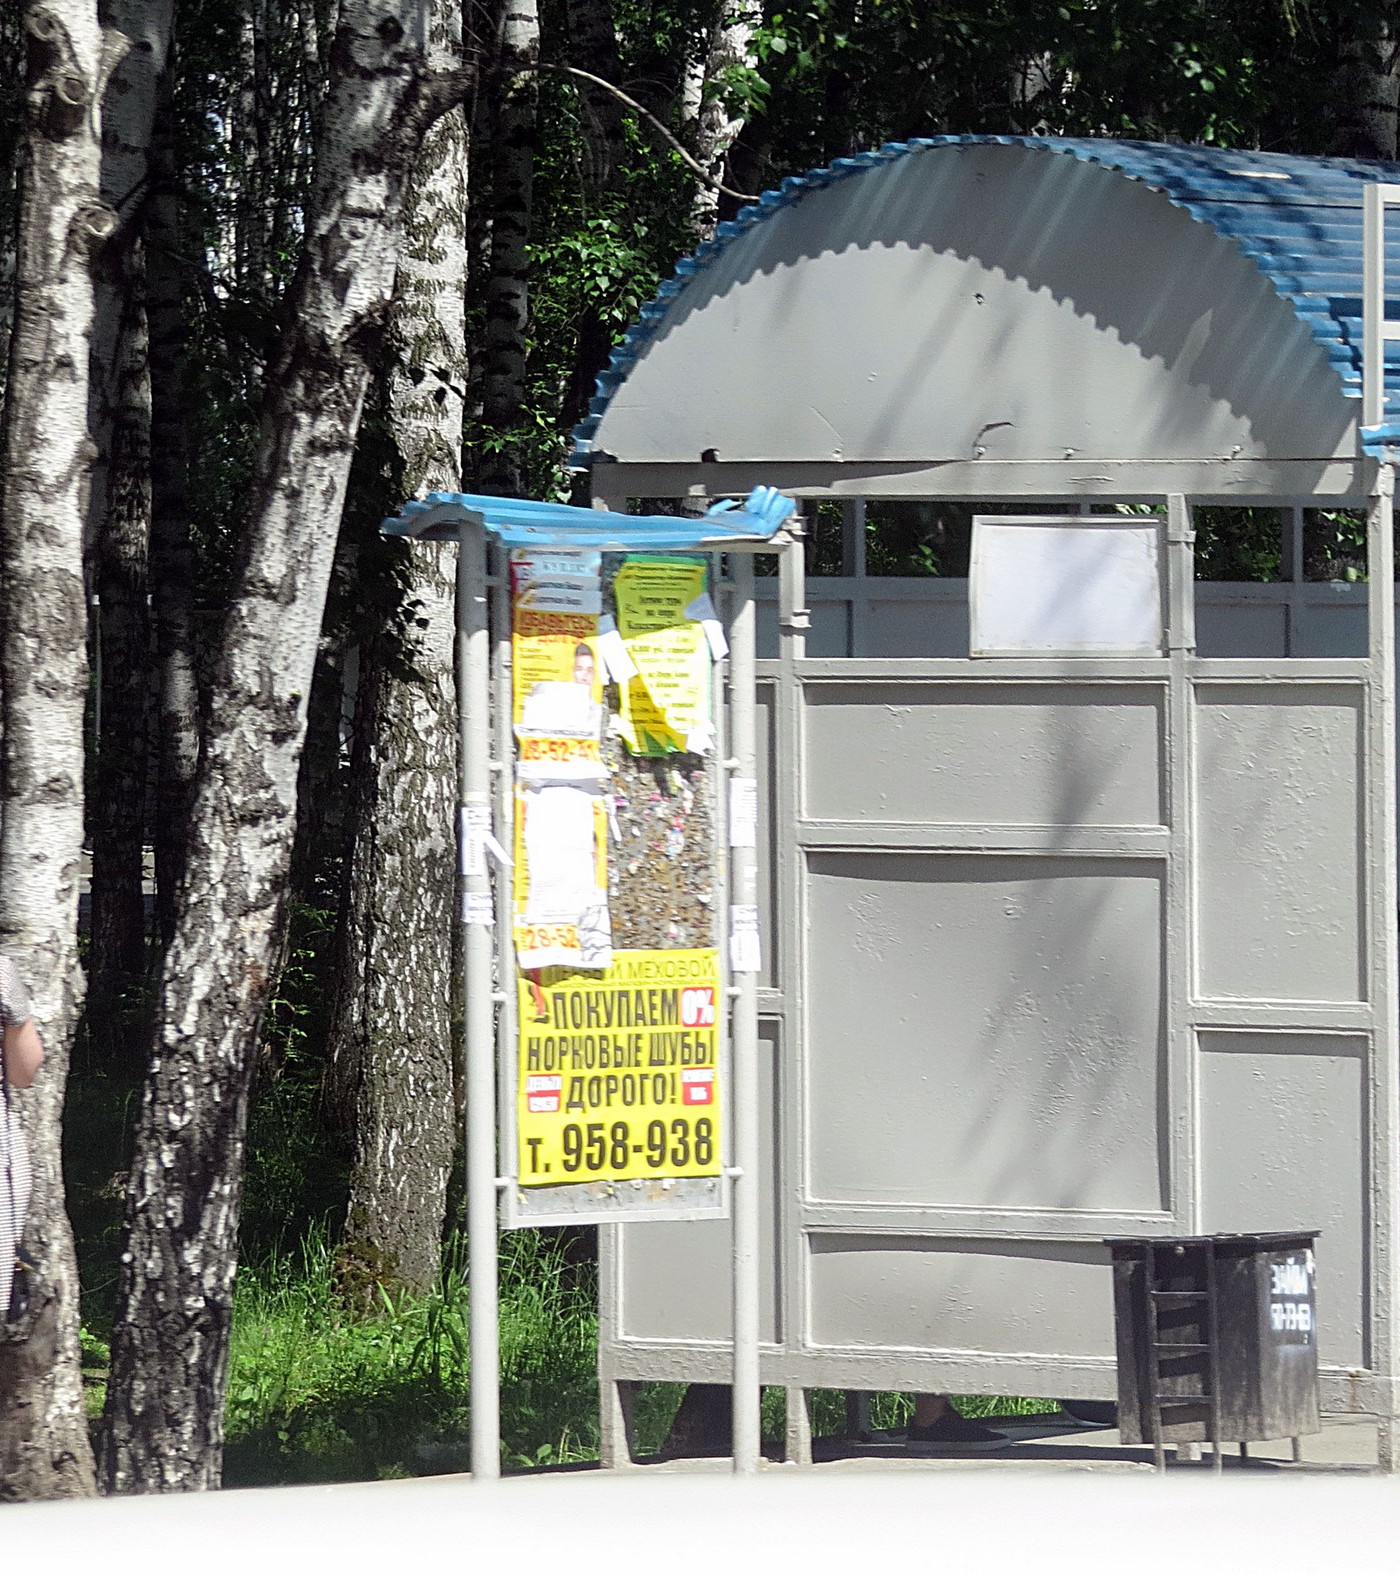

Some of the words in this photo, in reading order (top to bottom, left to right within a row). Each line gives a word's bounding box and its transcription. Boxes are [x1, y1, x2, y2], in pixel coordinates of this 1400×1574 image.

[526, 927, 580, 950] 28-52
[626, 956, 716, 979] МЕХОВОЙ
[552, 988, 679, 1029] ПОКУПАЕМ
[526, 1033, 643, 1071] НОРКОВЫЕ
[649, 1031, 714, 1066] ШУБЫ
[566, 1073, 677, 1113] ДОРОГО!
[562, 1117, 713, 1172] 958-938
